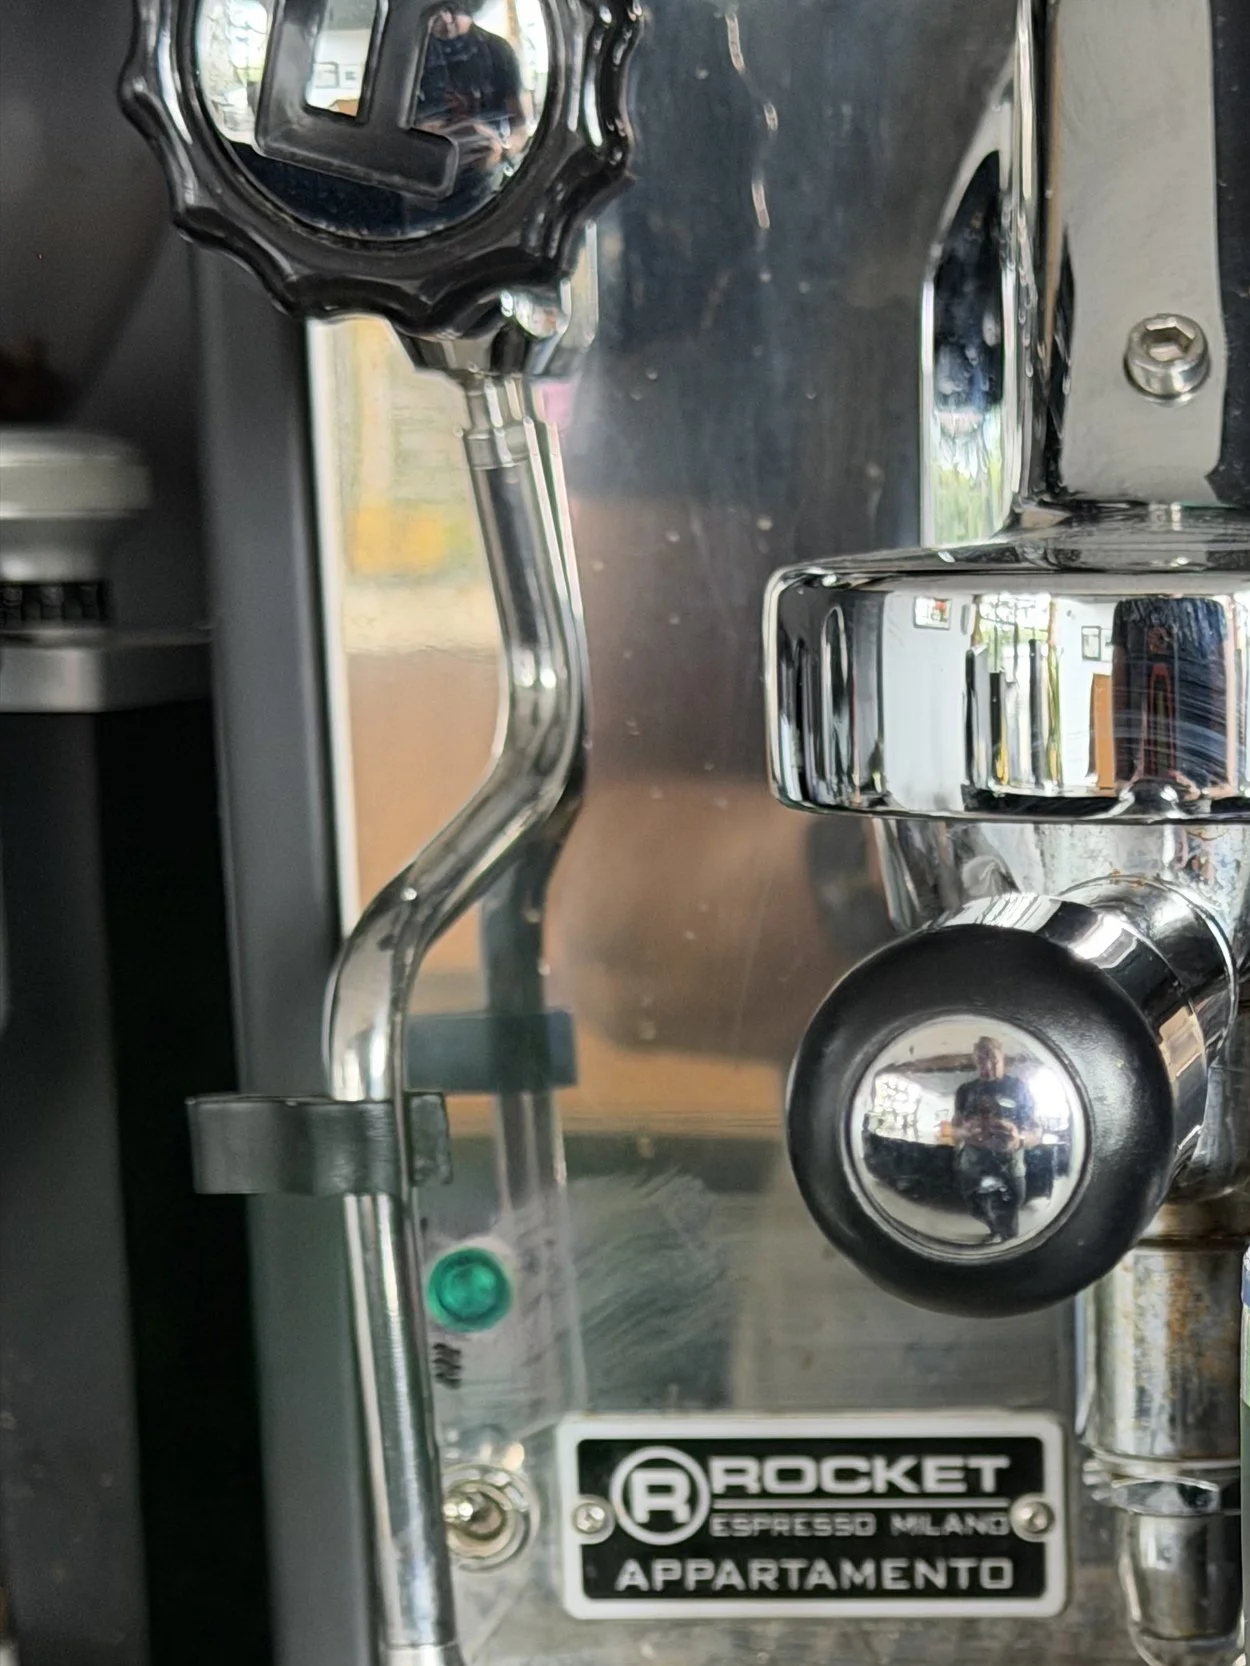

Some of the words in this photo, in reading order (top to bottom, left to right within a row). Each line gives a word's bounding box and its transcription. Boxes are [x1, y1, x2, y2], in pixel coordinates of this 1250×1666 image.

[709, 1456, 1011, 1494] ROCKET
[629, 1467, 692, 1524] R
[710, 1512, 876, 1538] ESPRESSO
[891, 1512, 1012, 1538] MILANO
[614, 1557, 1015, 1592] APPARTAMENTO
